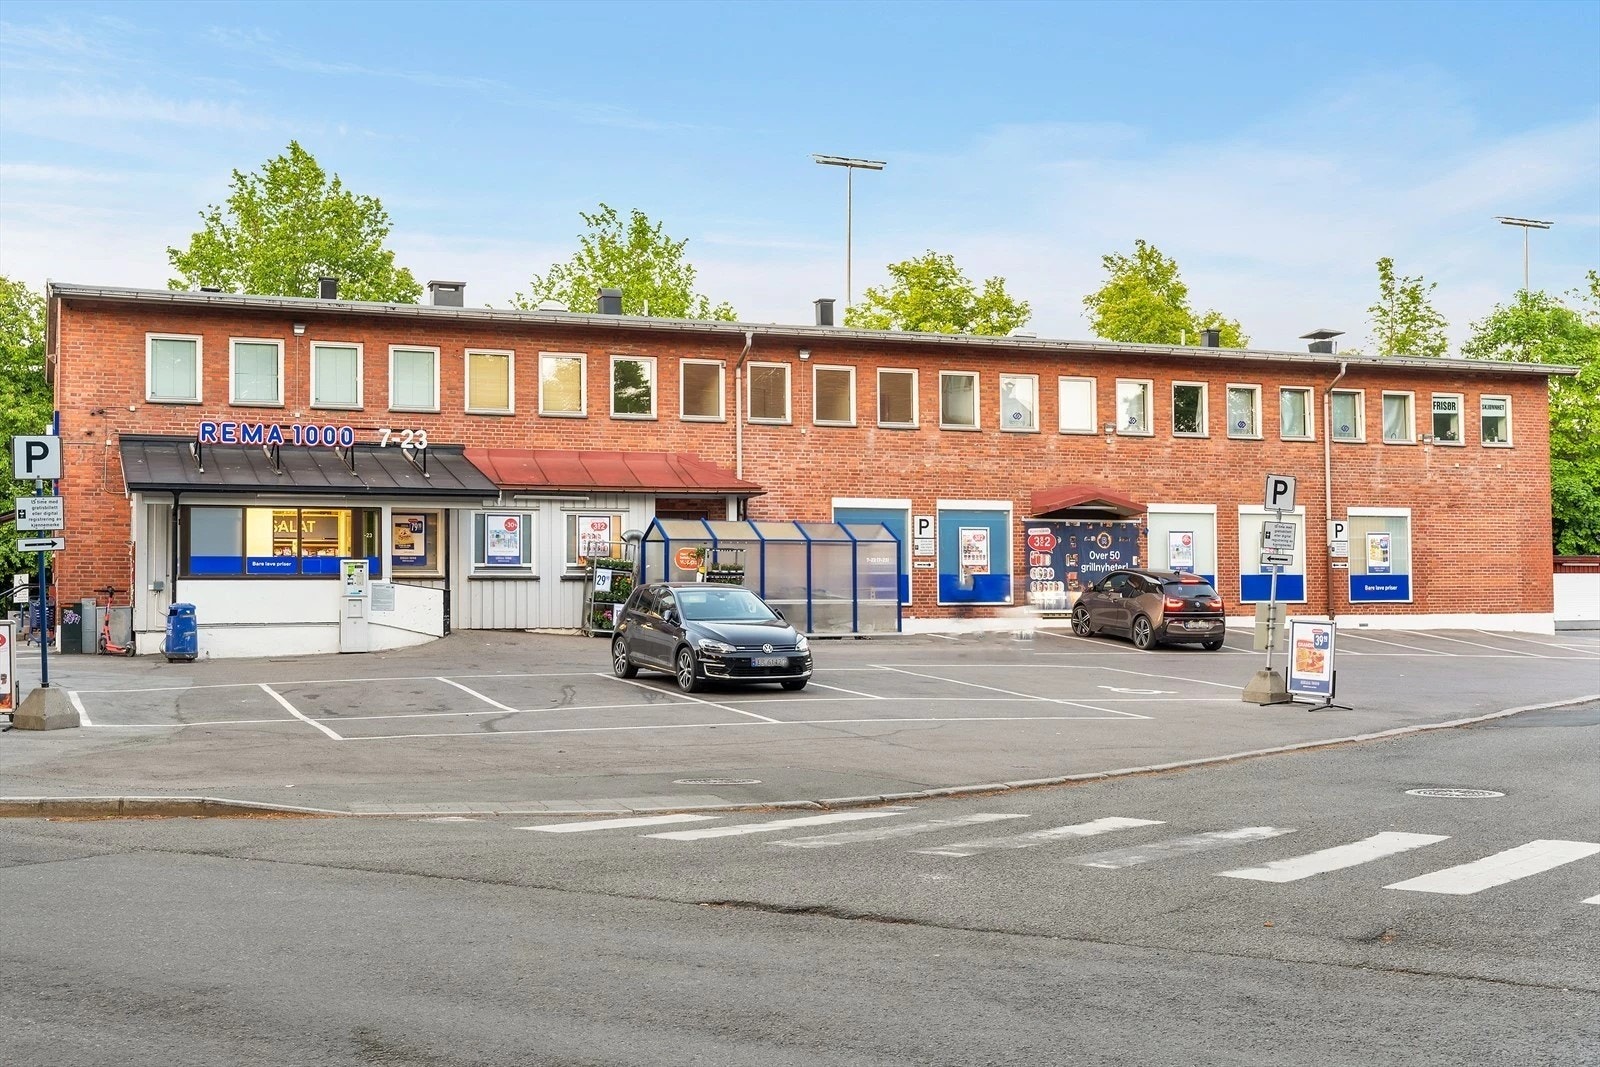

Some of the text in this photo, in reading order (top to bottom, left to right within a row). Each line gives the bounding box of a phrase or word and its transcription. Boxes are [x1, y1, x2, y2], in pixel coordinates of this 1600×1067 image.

[1433, 401, 1456, 410] FRISØR
[200, 421, 428, 449] REMA 1000 7-23
[26, 441, 49, 474] P
[1272, 480, 1288, 504] P
[919, 519, 929, 535] P
[1335, 523, 1344, 538] P
[1089, 551, 1120, 560] Over 50
[597, 575, 605, 586] 29
[1315, 635, 1323, 646] 39
